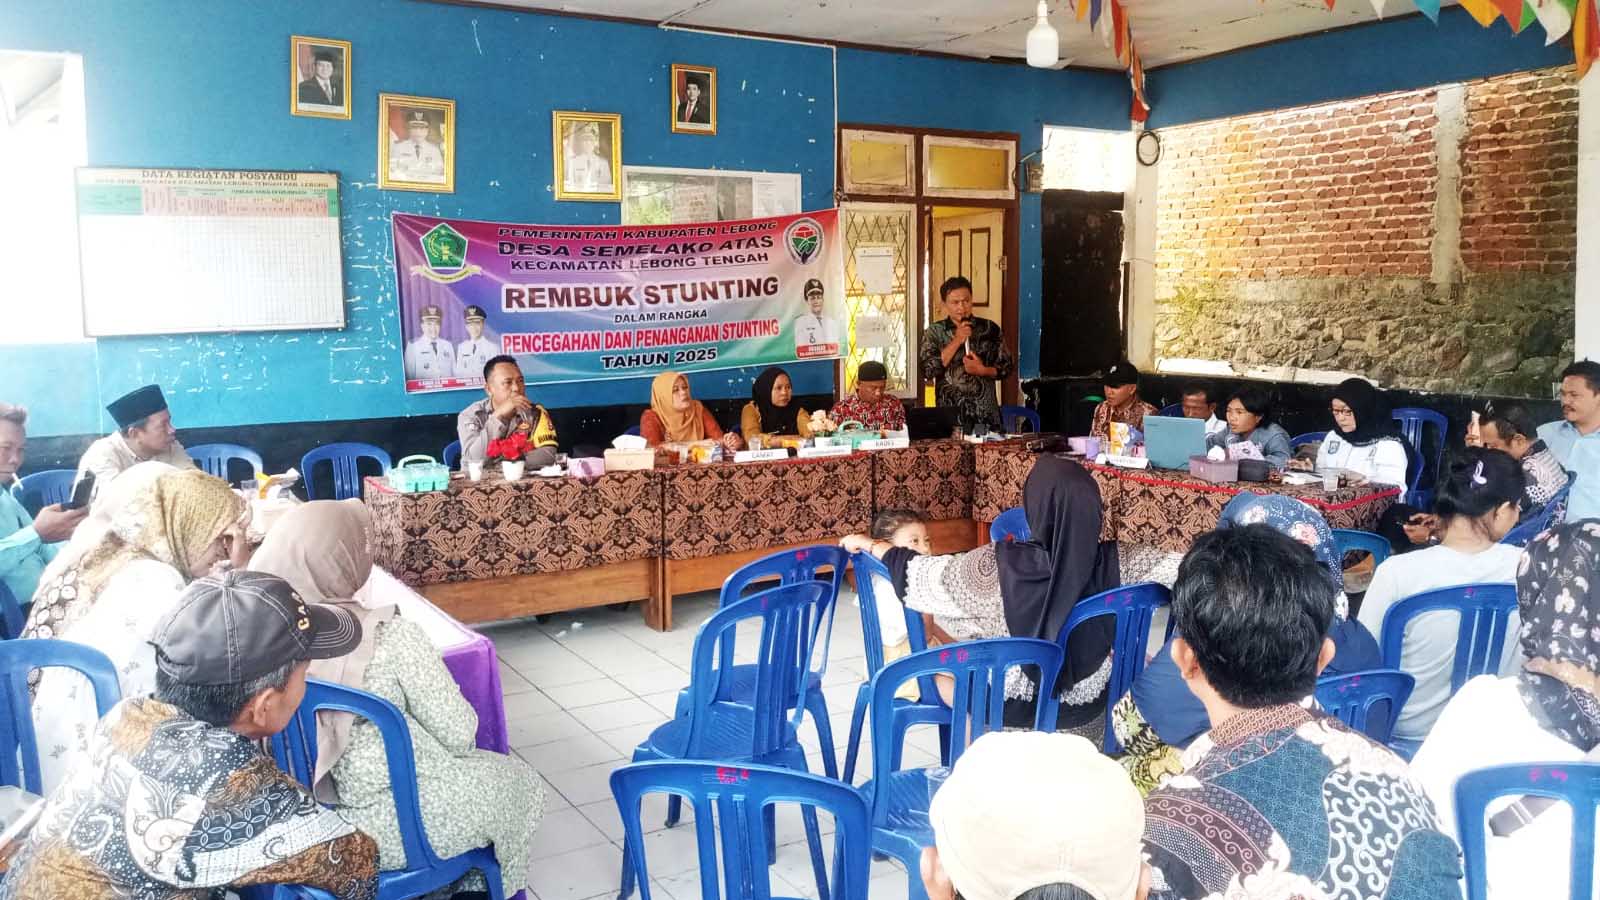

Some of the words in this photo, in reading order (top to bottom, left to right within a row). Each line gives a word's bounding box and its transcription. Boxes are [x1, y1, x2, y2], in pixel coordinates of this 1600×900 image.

[142, 170, 174, 178] DATA
[177, 171, 235, 180] KEGIATAN
[239, 172, 297, 181] POSYANDU
[498, 228, 618, 240] PEMERINTAH
[622, 227, 717, 240] KABUPATEN
[721, 221, 777, 235] LEBONG
[498, 241, 571, 256] DESA
[580, 242, 714, 257] SEMELAKO
[718, 235, 774, 251] ATAS
[511, 259, 622, 271] KECAMATAN
[629, 257, 697, 270] LEBONG
[701, 252, 769, 266] TENGAH
[504, 286, 636, 309] REMBUK
[643, 276, 779, 305] STUNTING
[614, 312, 656, 324] DALAM
[659, 309, 708, 321] RANGKA
[502, 333, 601, 354] PENCEGAHAN
[604, 331, 632, 350] DAN
[635, 324, 719, 348] PENANGANAN
[722, 319, 780, 341] STUNTING
[602, 353, 669, 369] TAHUN
[675, 348, 717, 363] 2025
